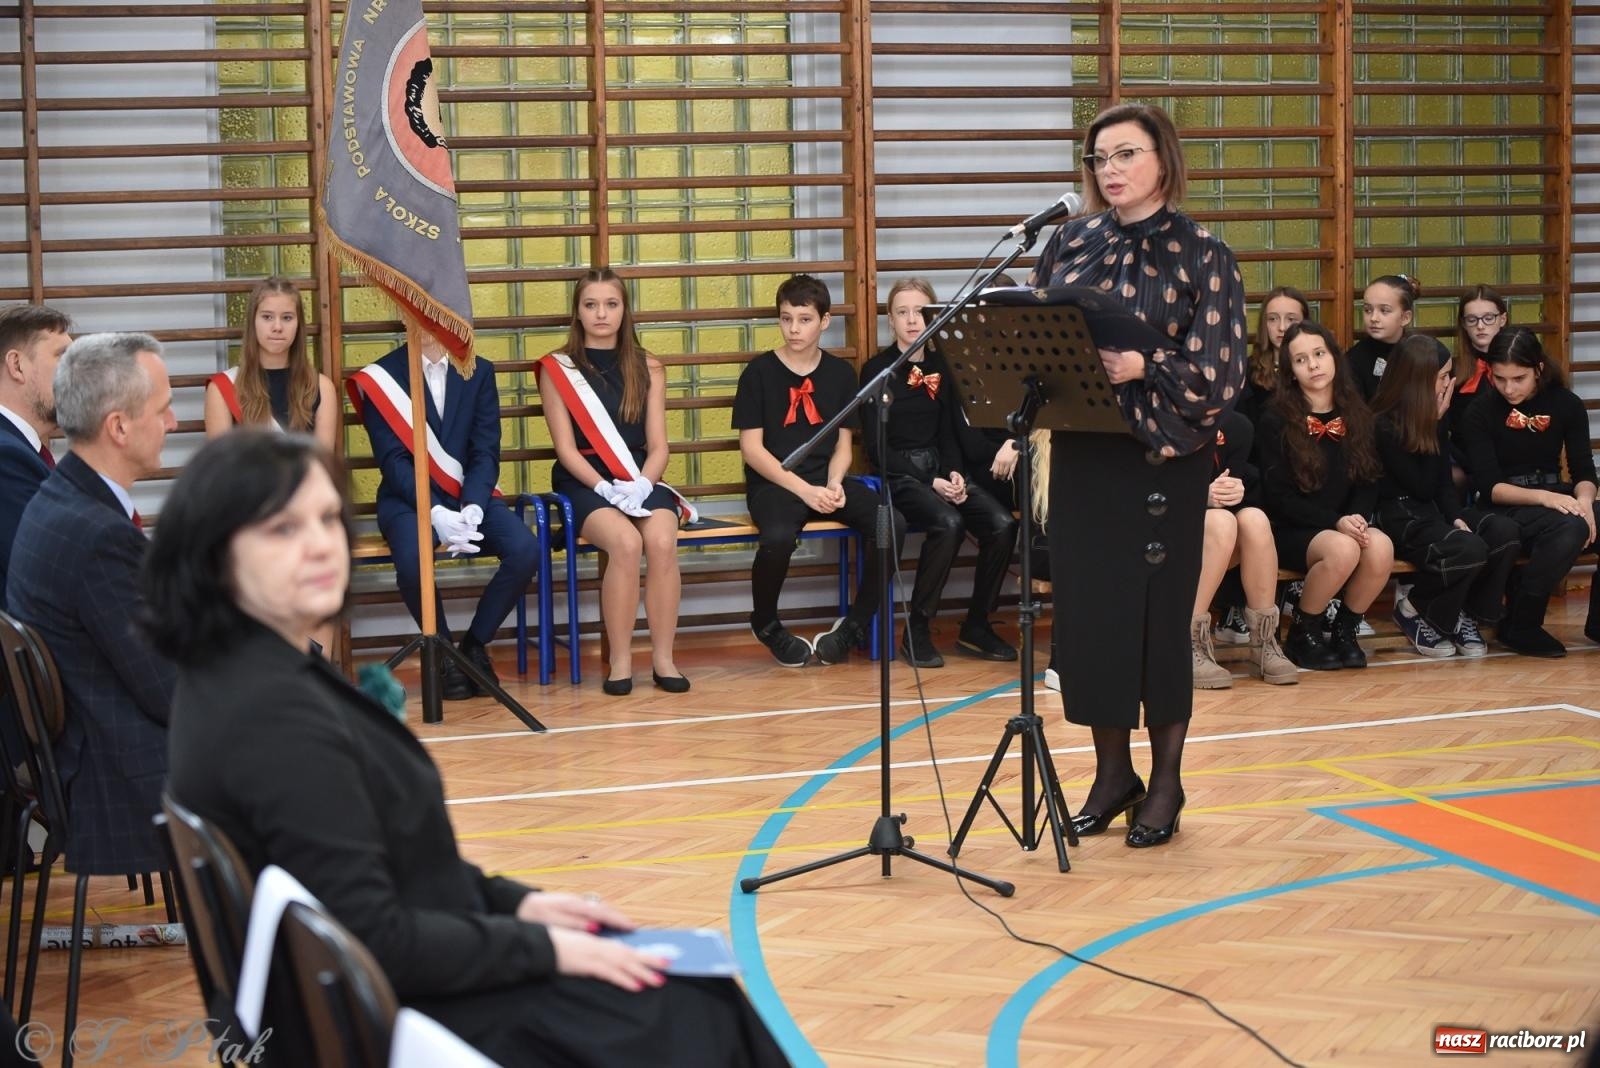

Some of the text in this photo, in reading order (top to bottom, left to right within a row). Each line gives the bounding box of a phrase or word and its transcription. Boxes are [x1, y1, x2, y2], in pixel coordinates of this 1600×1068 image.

[342, 0, 441, 241] SZKOŁA PODSTAWOWA NR
